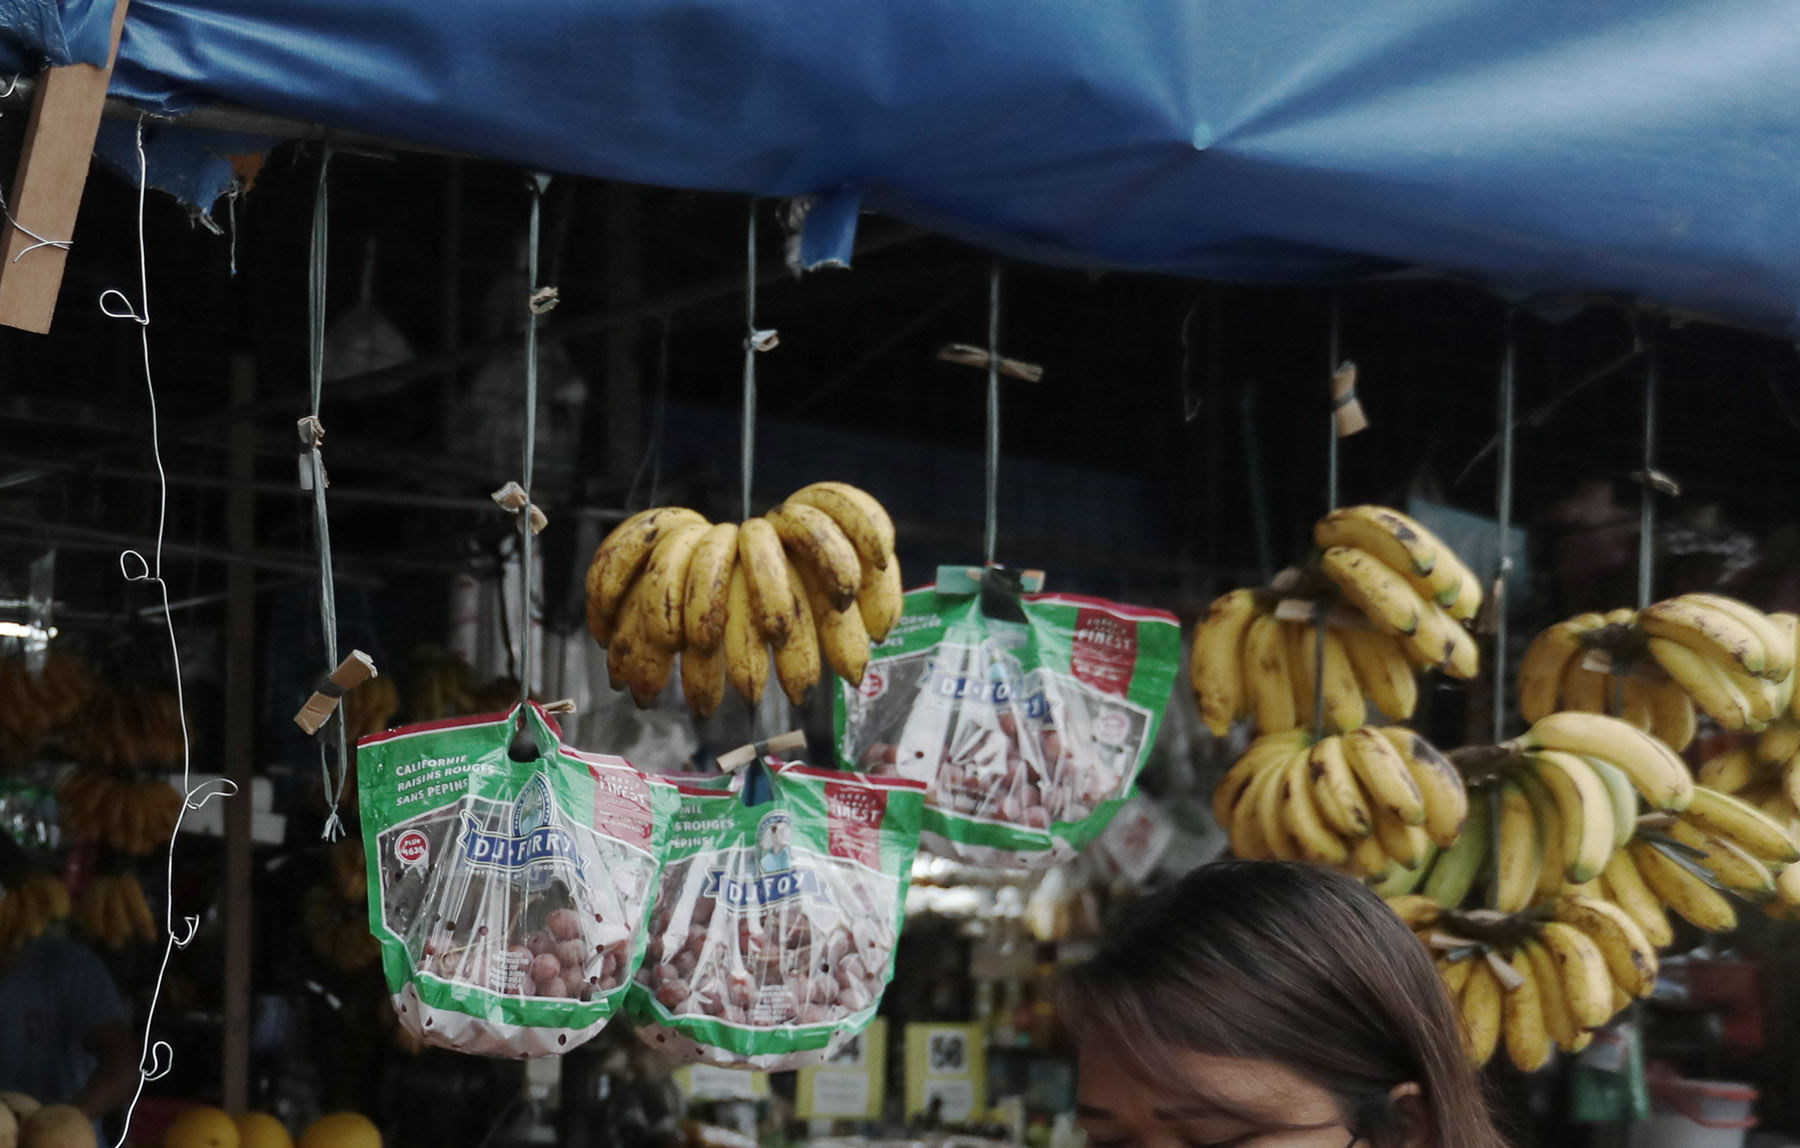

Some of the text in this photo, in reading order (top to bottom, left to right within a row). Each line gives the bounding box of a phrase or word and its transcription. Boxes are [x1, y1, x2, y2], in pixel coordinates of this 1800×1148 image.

[395, 755, 468, 777] CALIFORNIE
[397, 763, 495, 793] RAISINS ROUGES
[395, 778, 469, 807] SANS PÉPINS
